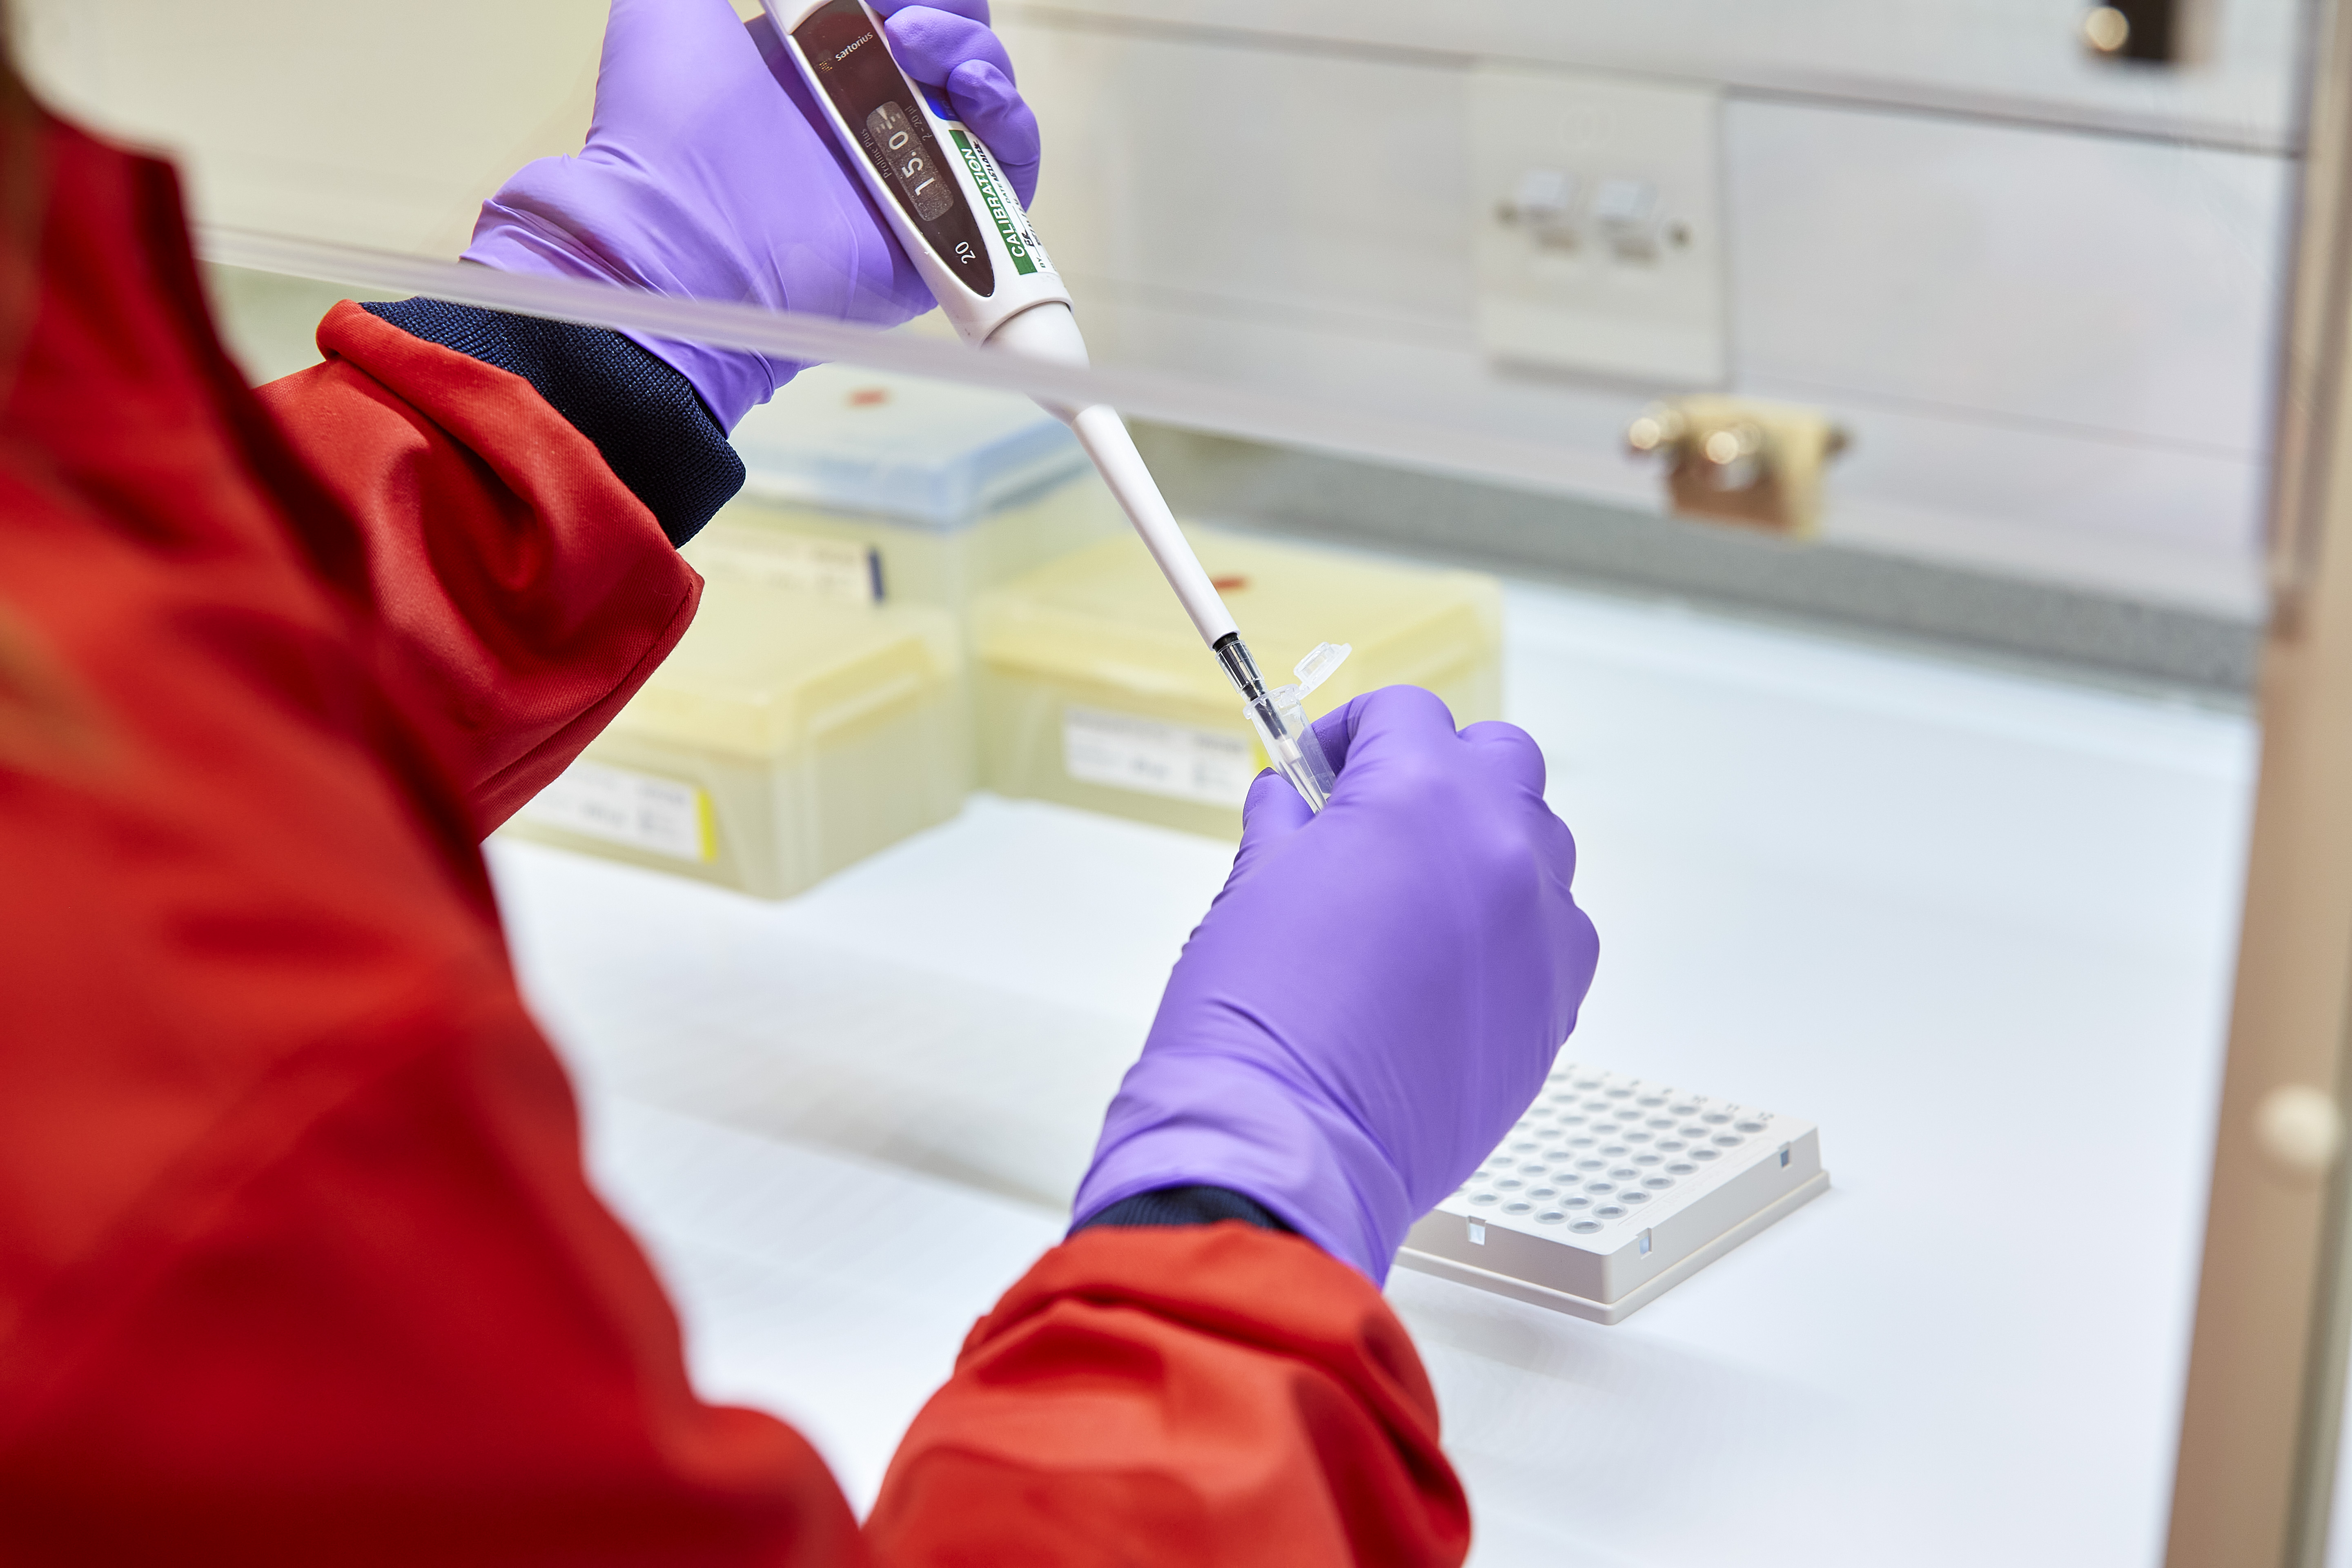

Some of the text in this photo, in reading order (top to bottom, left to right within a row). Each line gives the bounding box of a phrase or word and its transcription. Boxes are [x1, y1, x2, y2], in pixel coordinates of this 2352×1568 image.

[835, 32, 873, 61] sartorius
[911, 115, 922, 127] 20
[961, 148, 1025, 257] CALIBRATION
[997, 183, 1011, 204] DATE
[955, 241, 976, 264] 20
[1036, 256, 1046, 268] BY
